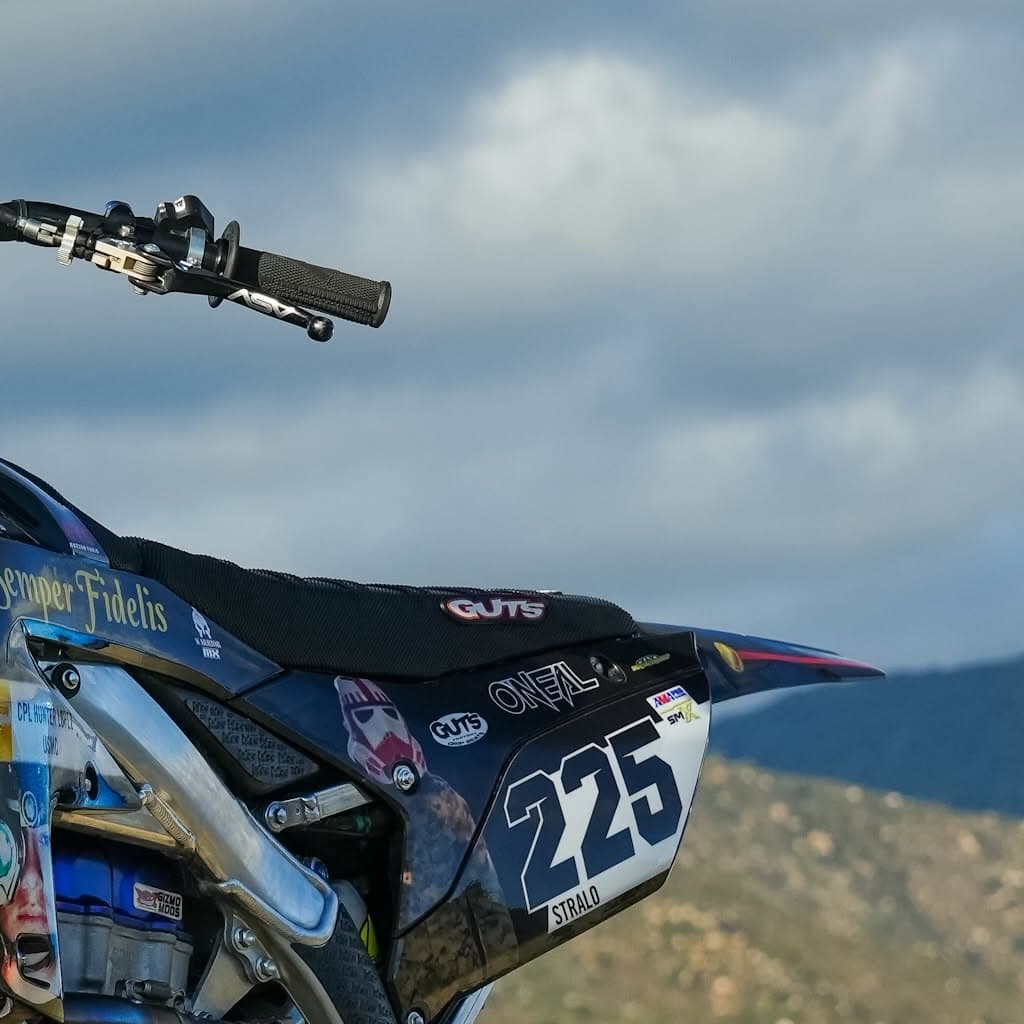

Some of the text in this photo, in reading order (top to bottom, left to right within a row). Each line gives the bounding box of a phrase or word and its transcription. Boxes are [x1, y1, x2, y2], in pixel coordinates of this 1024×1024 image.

[75, 569, 169, 634] Fidelis
[446, 599, 546, 620] GUTS
[17, 702, 33, 722] CPL
[430, 712, 482, 739] GUTS
[504, 717, 682, 914] 225
[552, 887, 601, 926] STRALO
